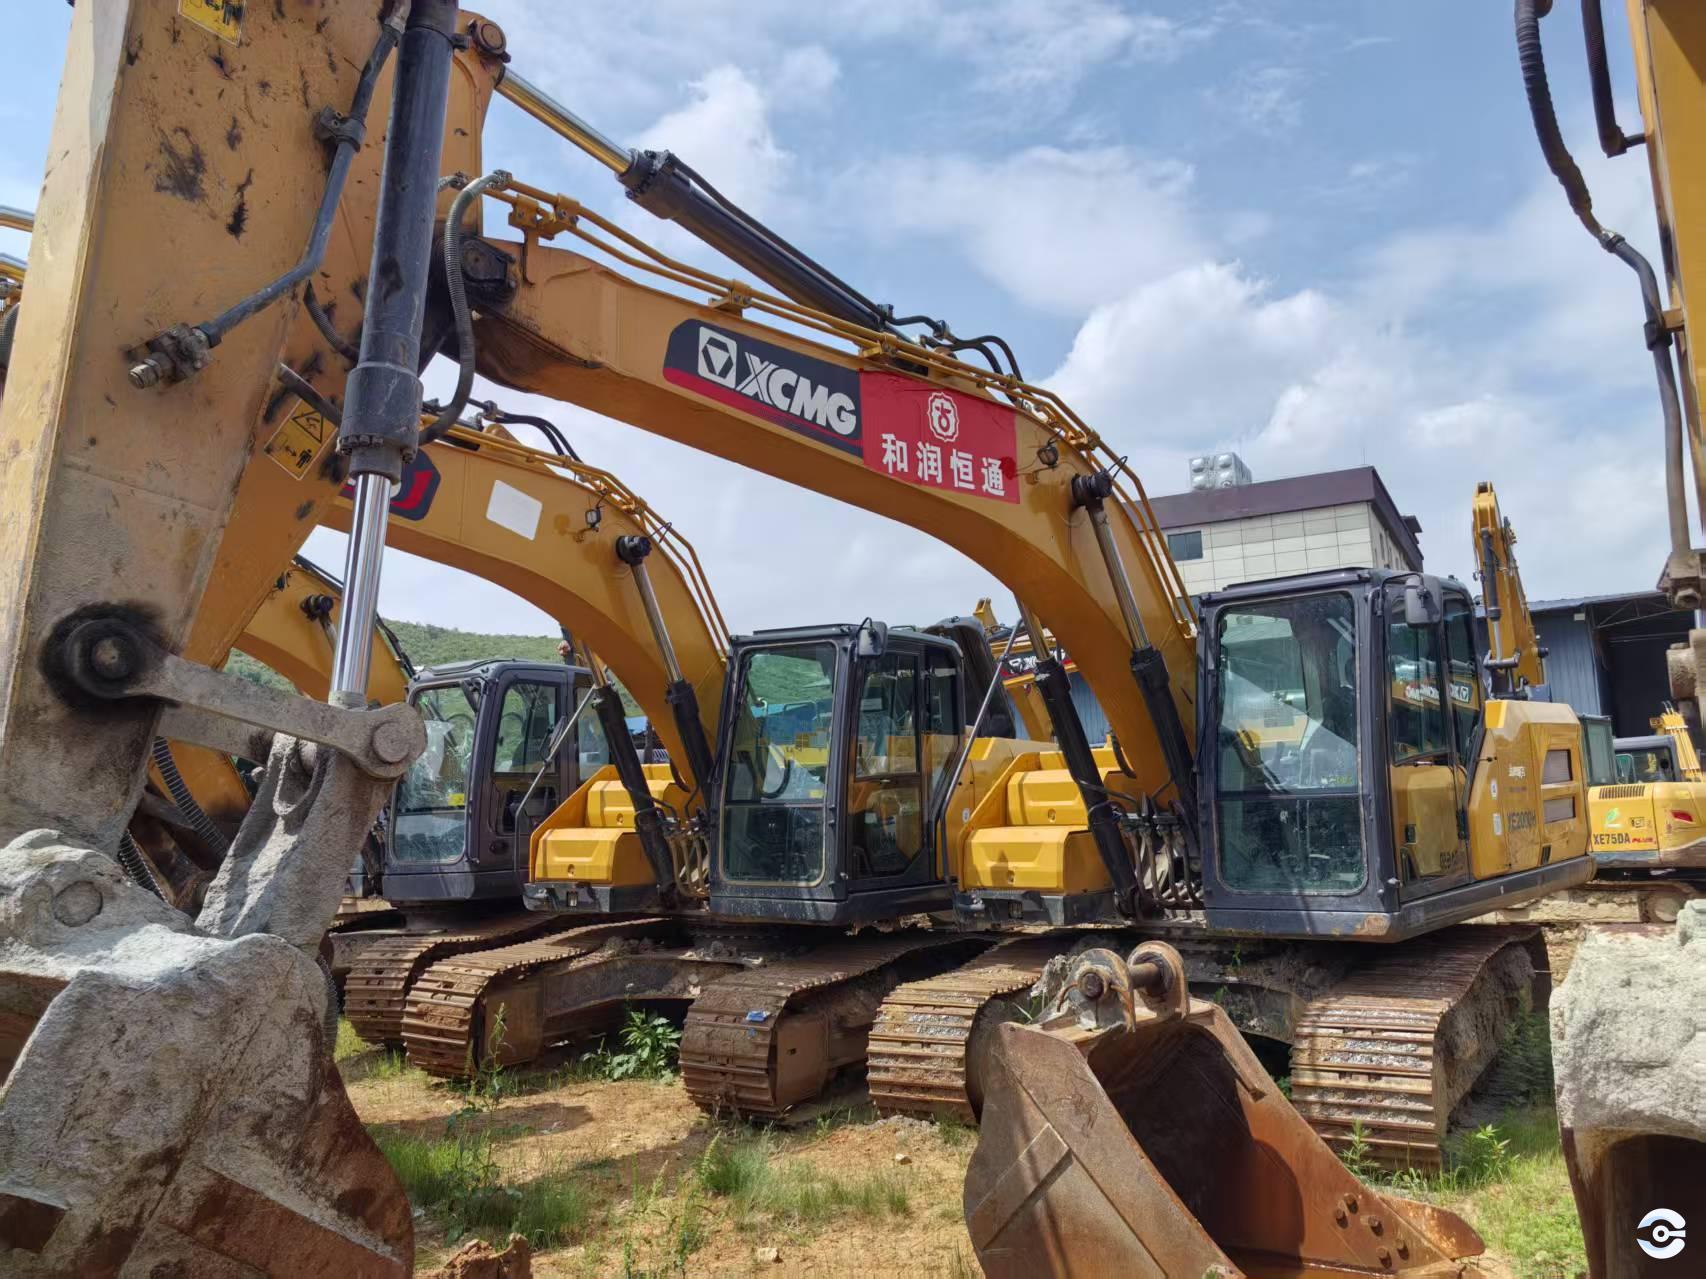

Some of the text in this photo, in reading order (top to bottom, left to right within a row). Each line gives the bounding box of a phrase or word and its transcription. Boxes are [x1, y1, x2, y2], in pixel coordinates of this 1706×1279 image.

[735, 351, 857, 435] XCMG
[880, 433, 1006, 497] 和润恒通
[1592, 832, 1632, 846] XE75DA
